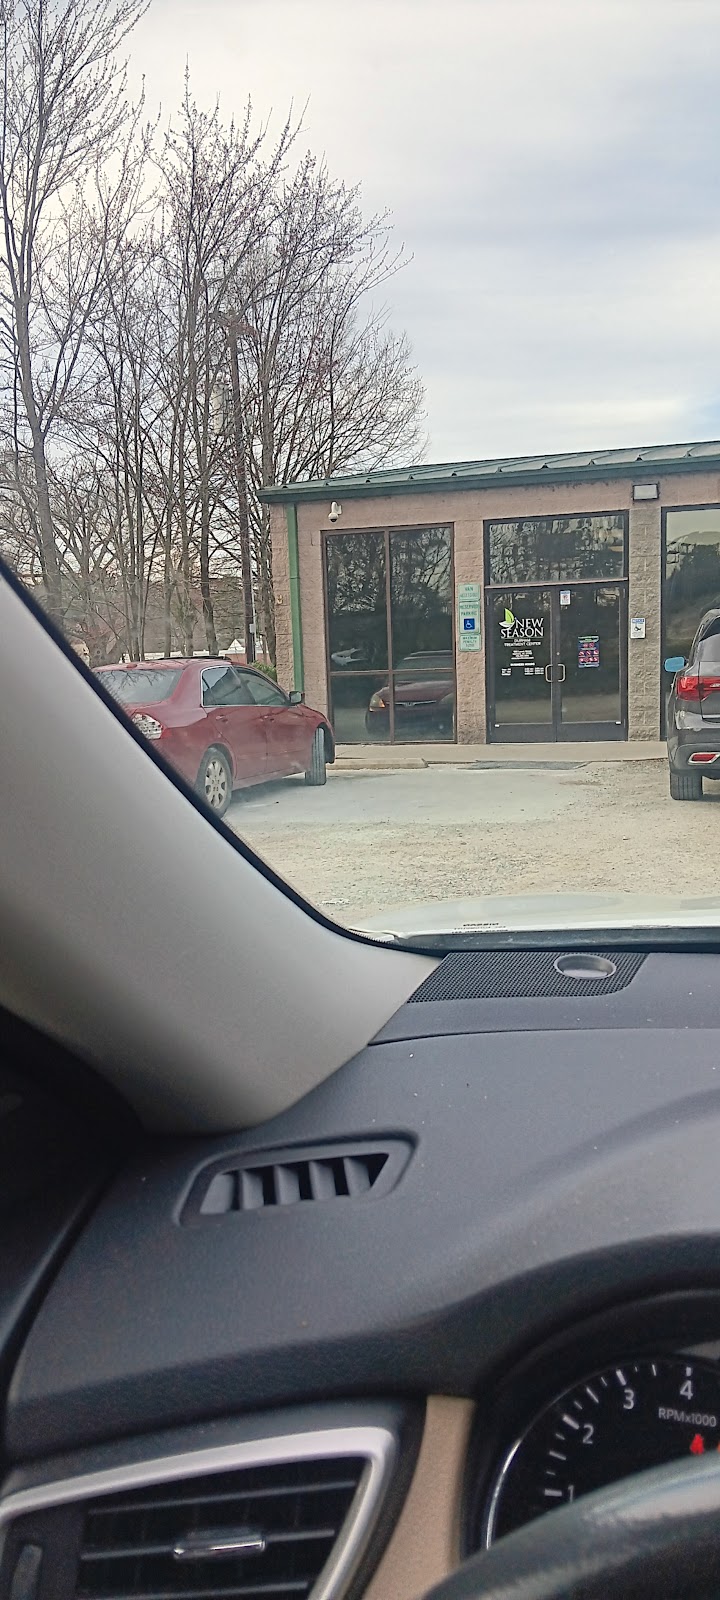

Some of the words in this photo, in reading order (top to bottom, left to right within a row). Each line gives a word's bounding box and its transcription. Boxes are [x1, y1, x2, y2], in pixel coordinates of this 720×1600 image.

[500, 627, 544, 638] SEASON
[514, 617, 544, 628] NEW
[623, 1388, 635, 1410] 3
[679, 1380, 694, 1400] 4
[658, 1406, 717, 1428] RPMx1000
[582, 1424, 595, 1444] 2
[567, 1484, 575, 1502] 1
